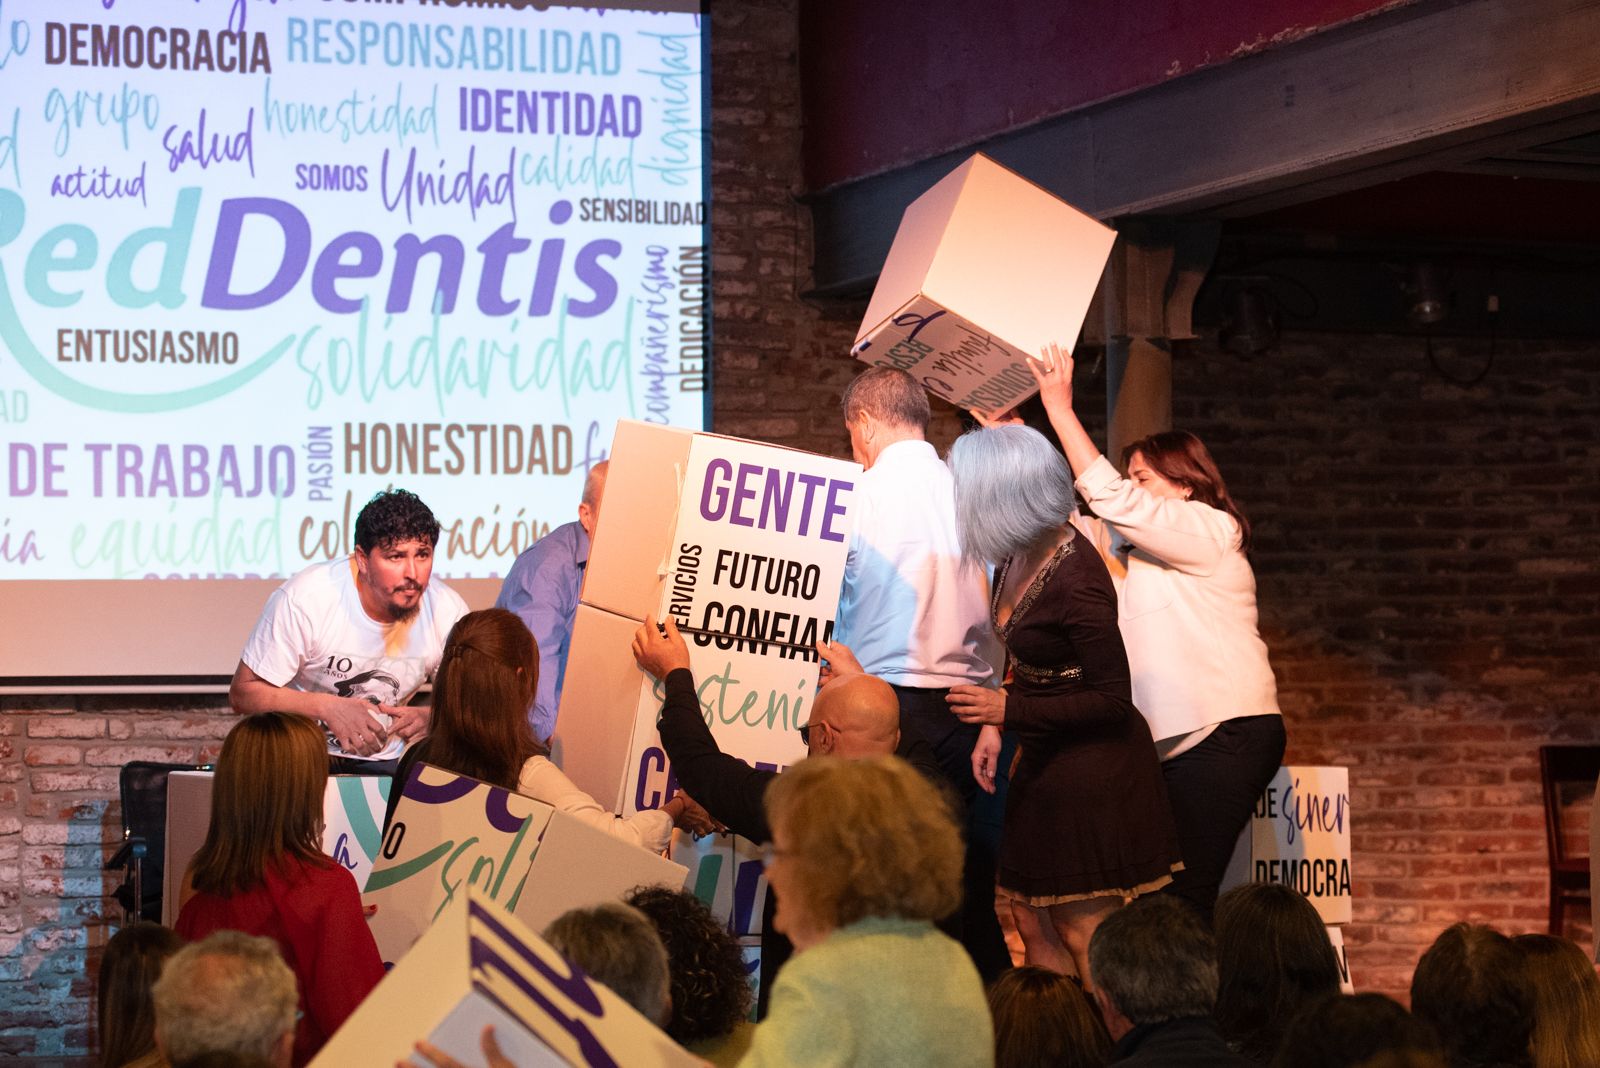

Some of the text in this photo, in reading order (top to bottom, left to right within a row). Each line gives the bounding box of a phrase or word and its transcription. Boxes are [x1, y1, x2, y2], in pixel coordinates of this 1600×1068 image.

[45, 22, 272, 74] DEMOCRACIA
[286, 17, 622, 77] RESPONSABILIDAD
[44, 81, 160, 158] grupo
[264, 76, 440, 150] honestidad
[458, 86, 643, 139] IDENTIDAD
[637, 29, 710, 187] dignidad
[162, 107, 255, 179] salud
[295, 163, 369, 192] SOMOS
[519, 134, 637, 203] calidad
[51, 161, 148, 208] actitud
[381, 145, 518, 225] Unidad
[579, 197, 708, 226] SENSIBILIDAD
[57, 328, 240, 365] ENTUSIASMO
[673, 245, 710, 393] DEDICACIÓN
[295, 293, 637, 420] solidaridad
[8, 442, 297, 499] DE TRABAJO
[302, 425, 334, 502] PASIÓN
[344, 422, 573, 476] HONESTIDAD
[69, 474, 285, 580] equidad
[699, 457, 855, 543] GENTE
[668, 542, 703, 630] ERVICIOS
[712, 548, 821, 601] FUTURO
[326, 655, 353, 673] 10
